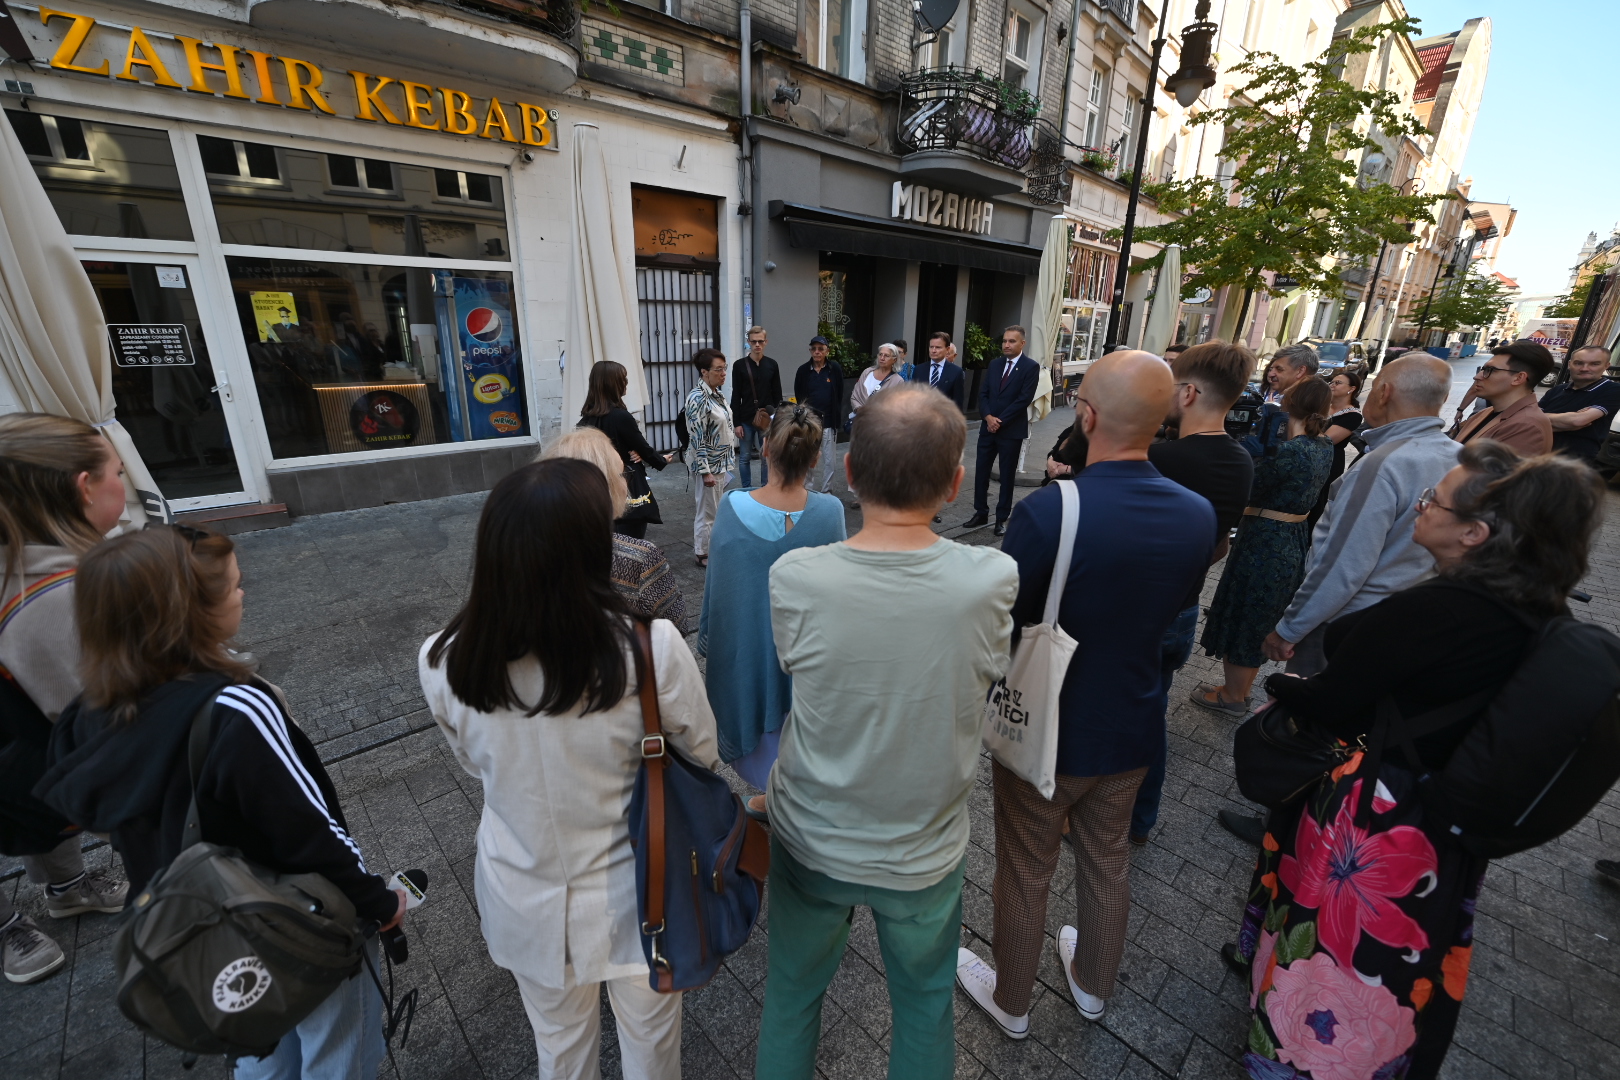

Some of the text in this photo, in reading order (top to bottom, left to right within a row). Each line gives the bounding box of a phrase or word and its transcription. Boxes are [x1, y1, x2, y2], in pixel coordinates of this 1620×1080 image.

[39, 5, 552, 147] ZAHIR KEBAB
[891, 180, 994, 236] MOZAIKA
[117, 327, 148, 335] ZAHIR
[472, 345, 502, 357] pepsi
[481, 383, 501, 394] Lipton
[365, 434, 388, 443] ZAHIR
